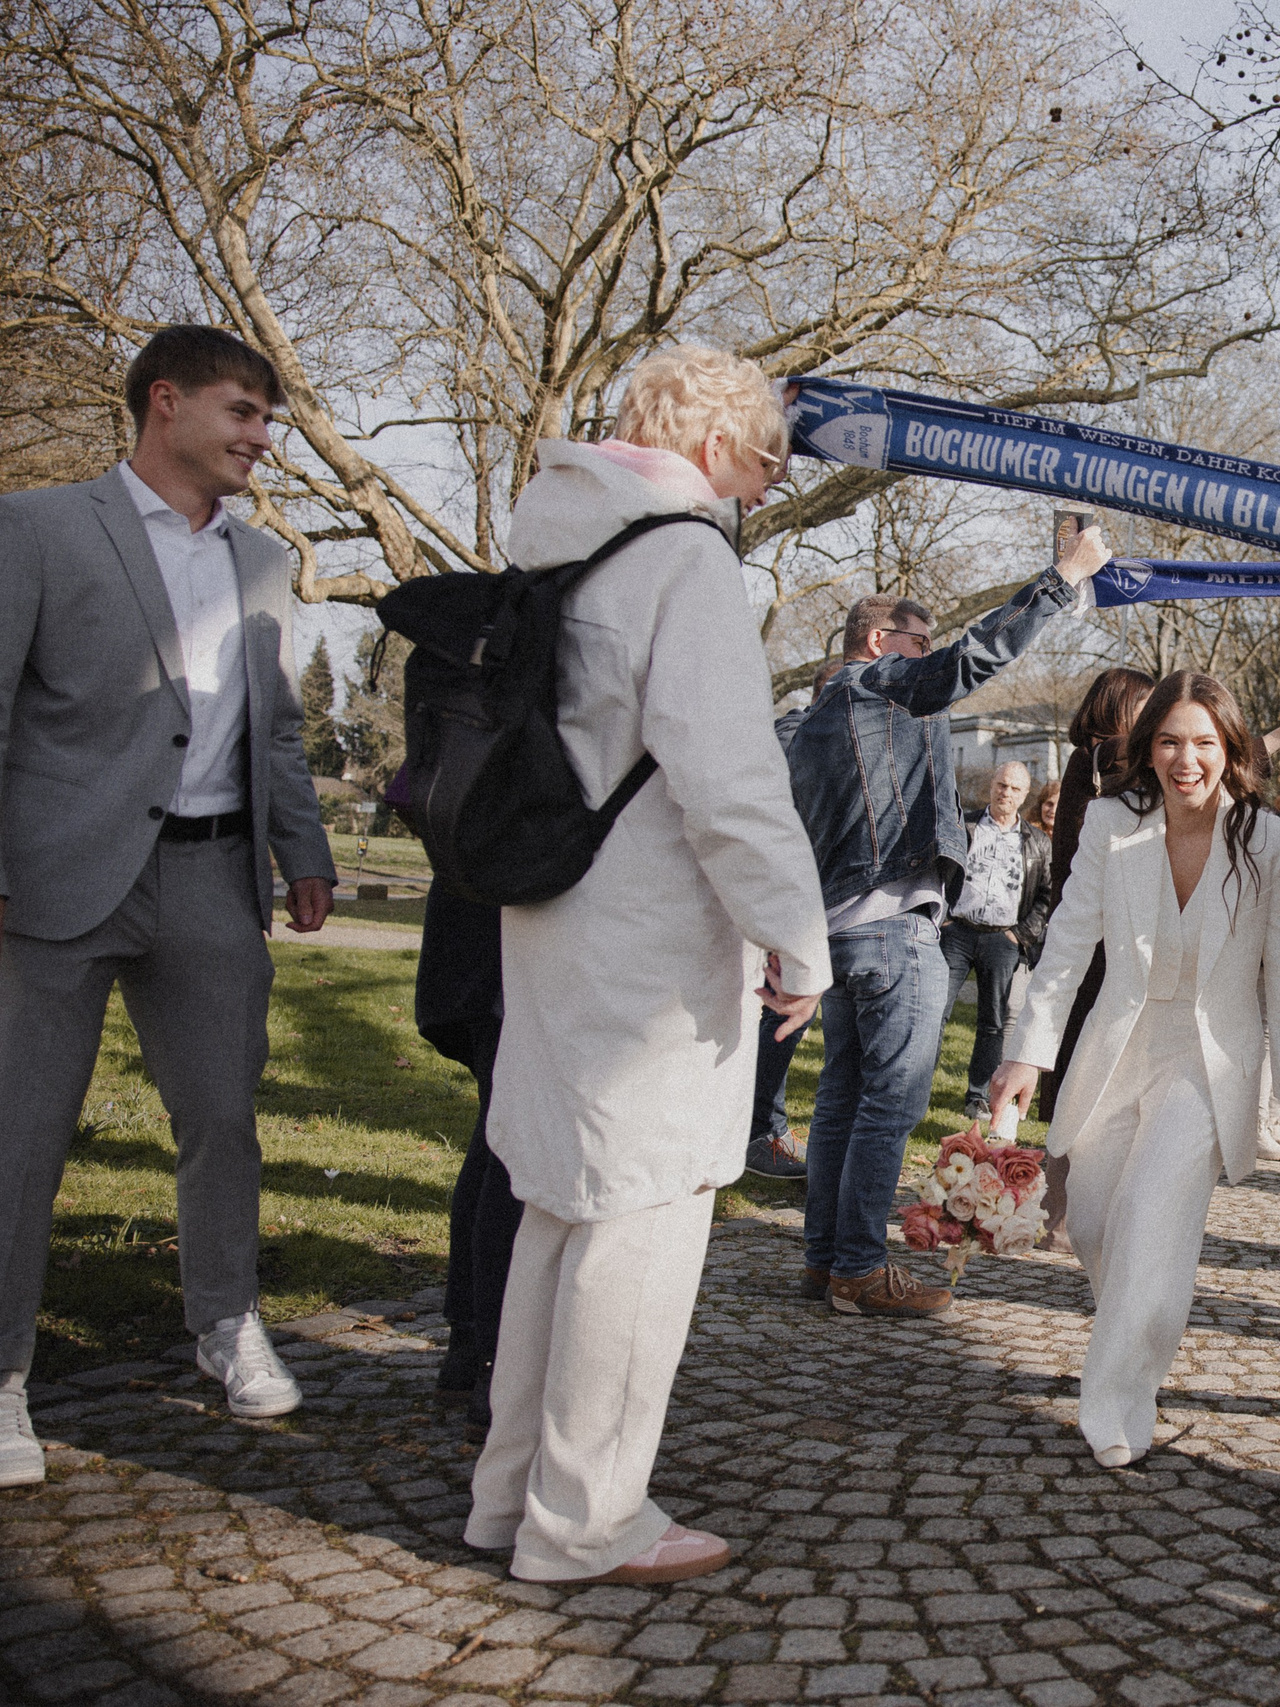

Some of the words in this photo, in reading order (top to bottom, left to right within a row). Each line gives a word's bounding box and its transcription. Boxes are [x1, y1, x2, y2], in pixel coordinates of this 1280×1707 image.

[905, 420, 1062, 486] BOCHUMER
[1063, 452, 1189, 514] JUNGEN
[1193, 479, 1229, 523] IN
[988, 411, 1036, 430] TIEF
[1040, 420, 1066, 435] IM
[1077, 428, 1170, 461] WESTEN,
[1176, 449, 1252, 477] DAHER
